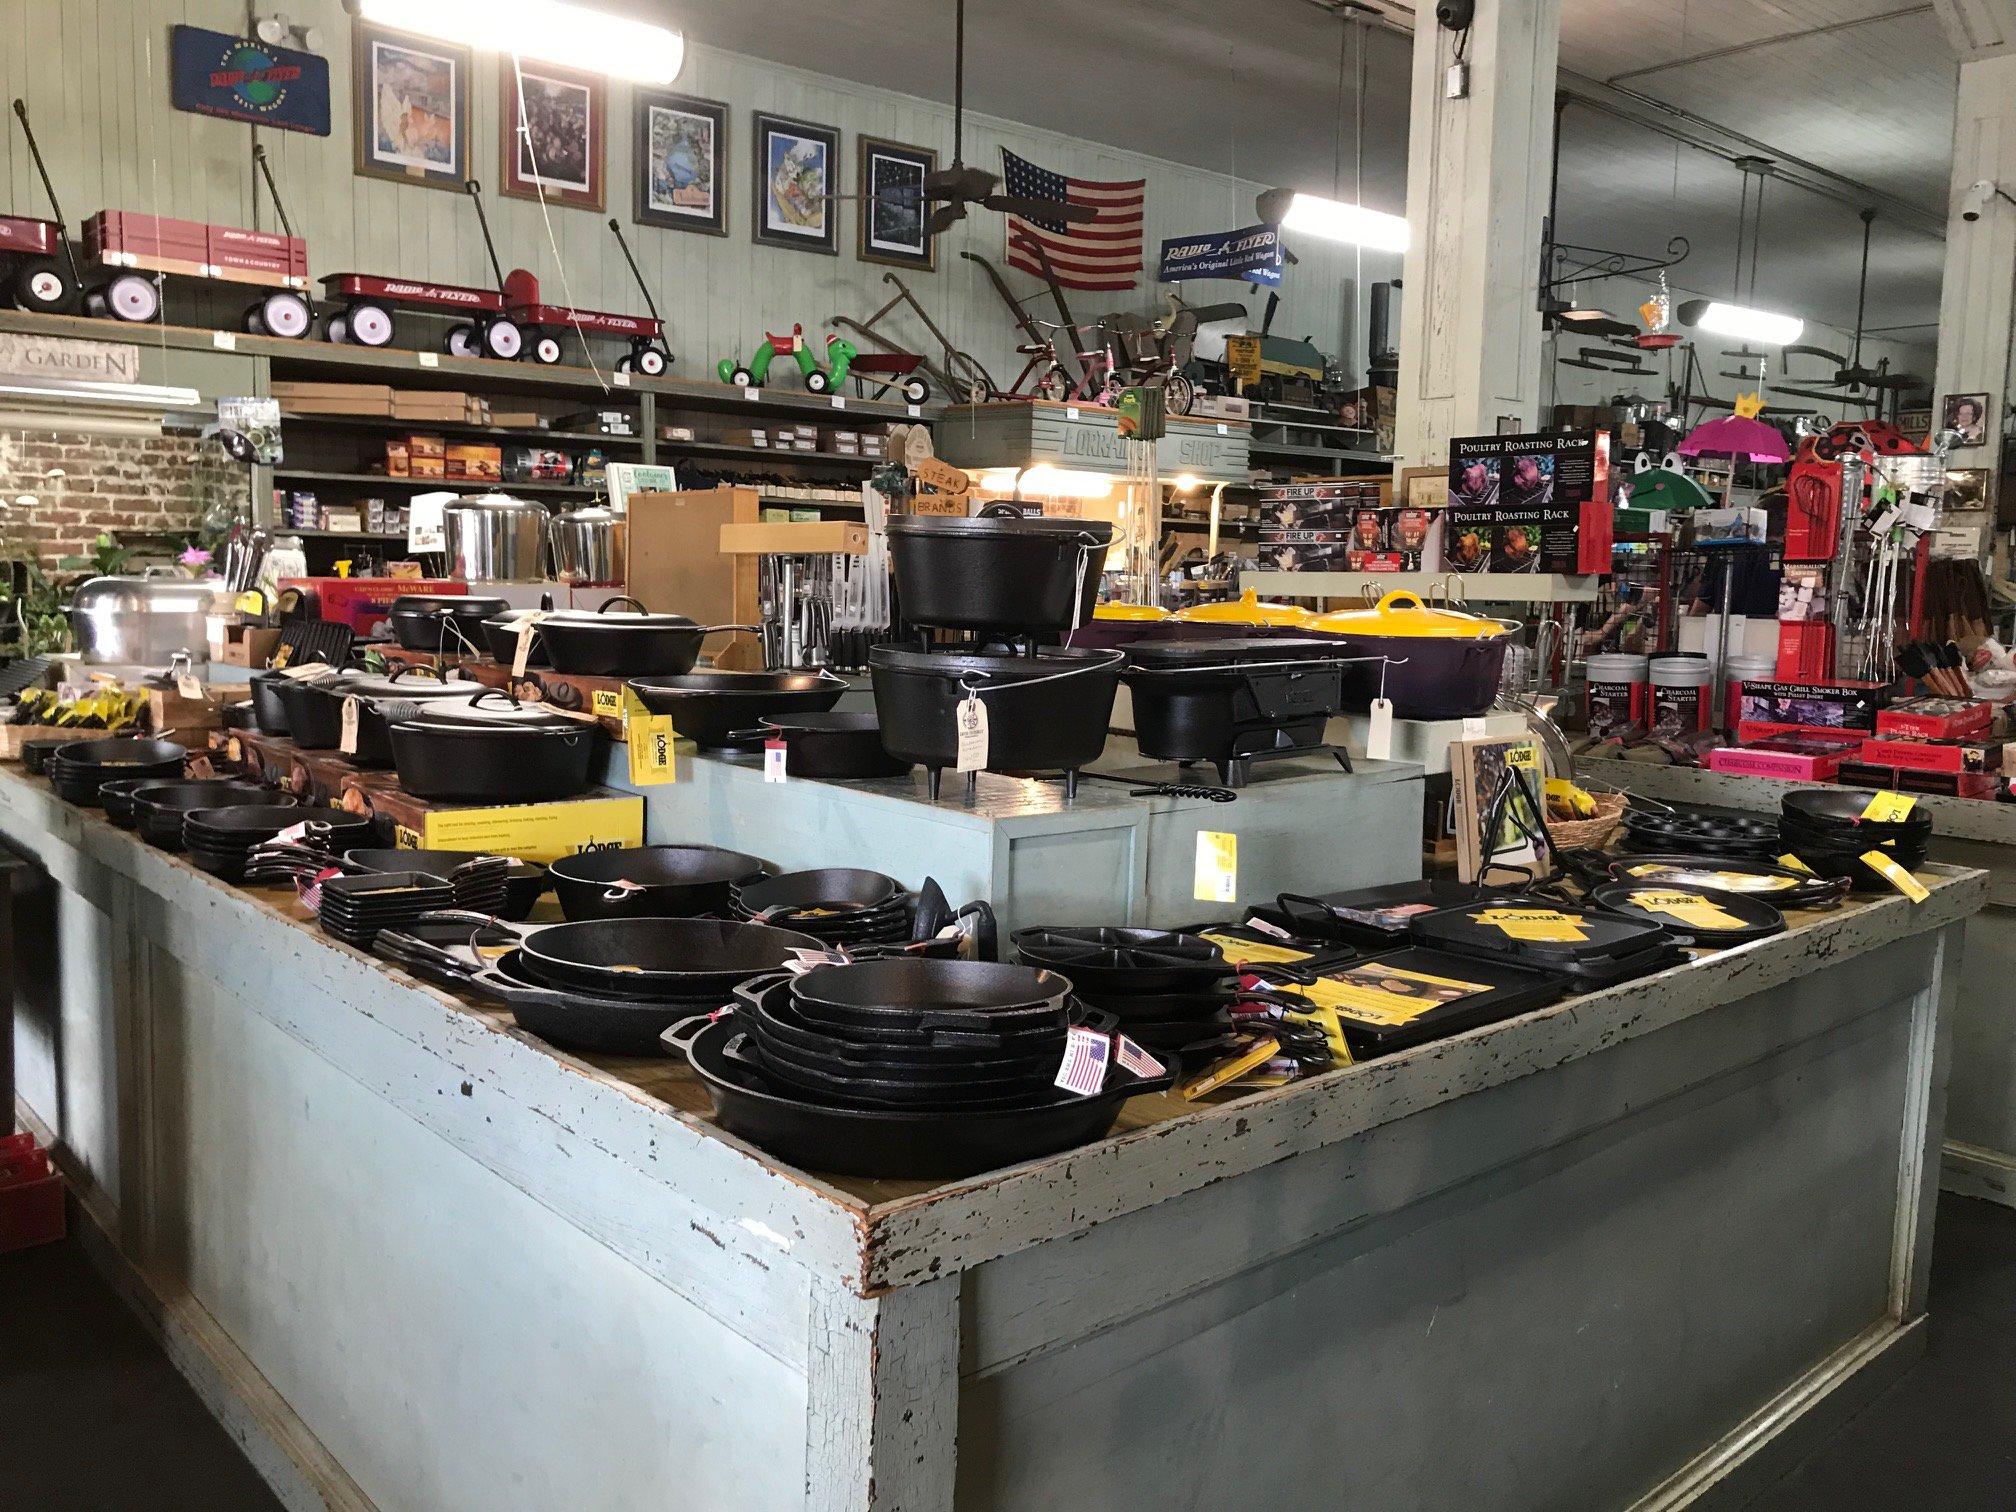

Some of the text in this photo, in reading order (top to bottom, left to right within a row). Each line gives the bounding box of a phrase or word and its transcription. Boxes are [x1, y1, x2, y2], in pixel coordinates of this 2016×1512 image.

[1164, 231, 1275, 260] RADIO FLYER
[1163, 262, 1198, 274] America's
[1199, 258, 1229, 271] Original
[1255, 250, 1275, 262] Wagon
[384, 283, 481, 303] RADIO FLYER
[607, 317, 638, 329] FLYER
[1180, 439, 1223, 467] SHOP
[1460, 438, 1584, 454] POULTRY ROASTING RACK
[923, 468, 961, 489] STEAK
[1286, 488, 1315, 496] FIRE UP
[917, 503, 962, 515] BRANDS
[1022, 507, 1041, 516] BALLS
[1454, 509, 1570, 523] POULTRY ROASTING RACK
[1285, 532, 1314, 540] FIRE UP
[397, 584, 435, 593] McWARE
[1594, 683, 1629, 692] CHARCOAL
[1600, 690, 1629, 698] STARTER
[1660, 687, 1697, 696] CHARCOAL
[1773, 683, 1788, 692] GAS
[1790, 685, 1811, 694] GRILL
[1812, 686, 1840, 695] SMOKER
[1842, 688, 1858, 697] BOX
[597, 692, 617, 707] LODGE
[656, 733, 667, 766] LODGE
[1509, 749, 1532, 763] LODGE
[399, 829, 418, 848] LODGE
[1491, 912, 1566, 923] LODGE
